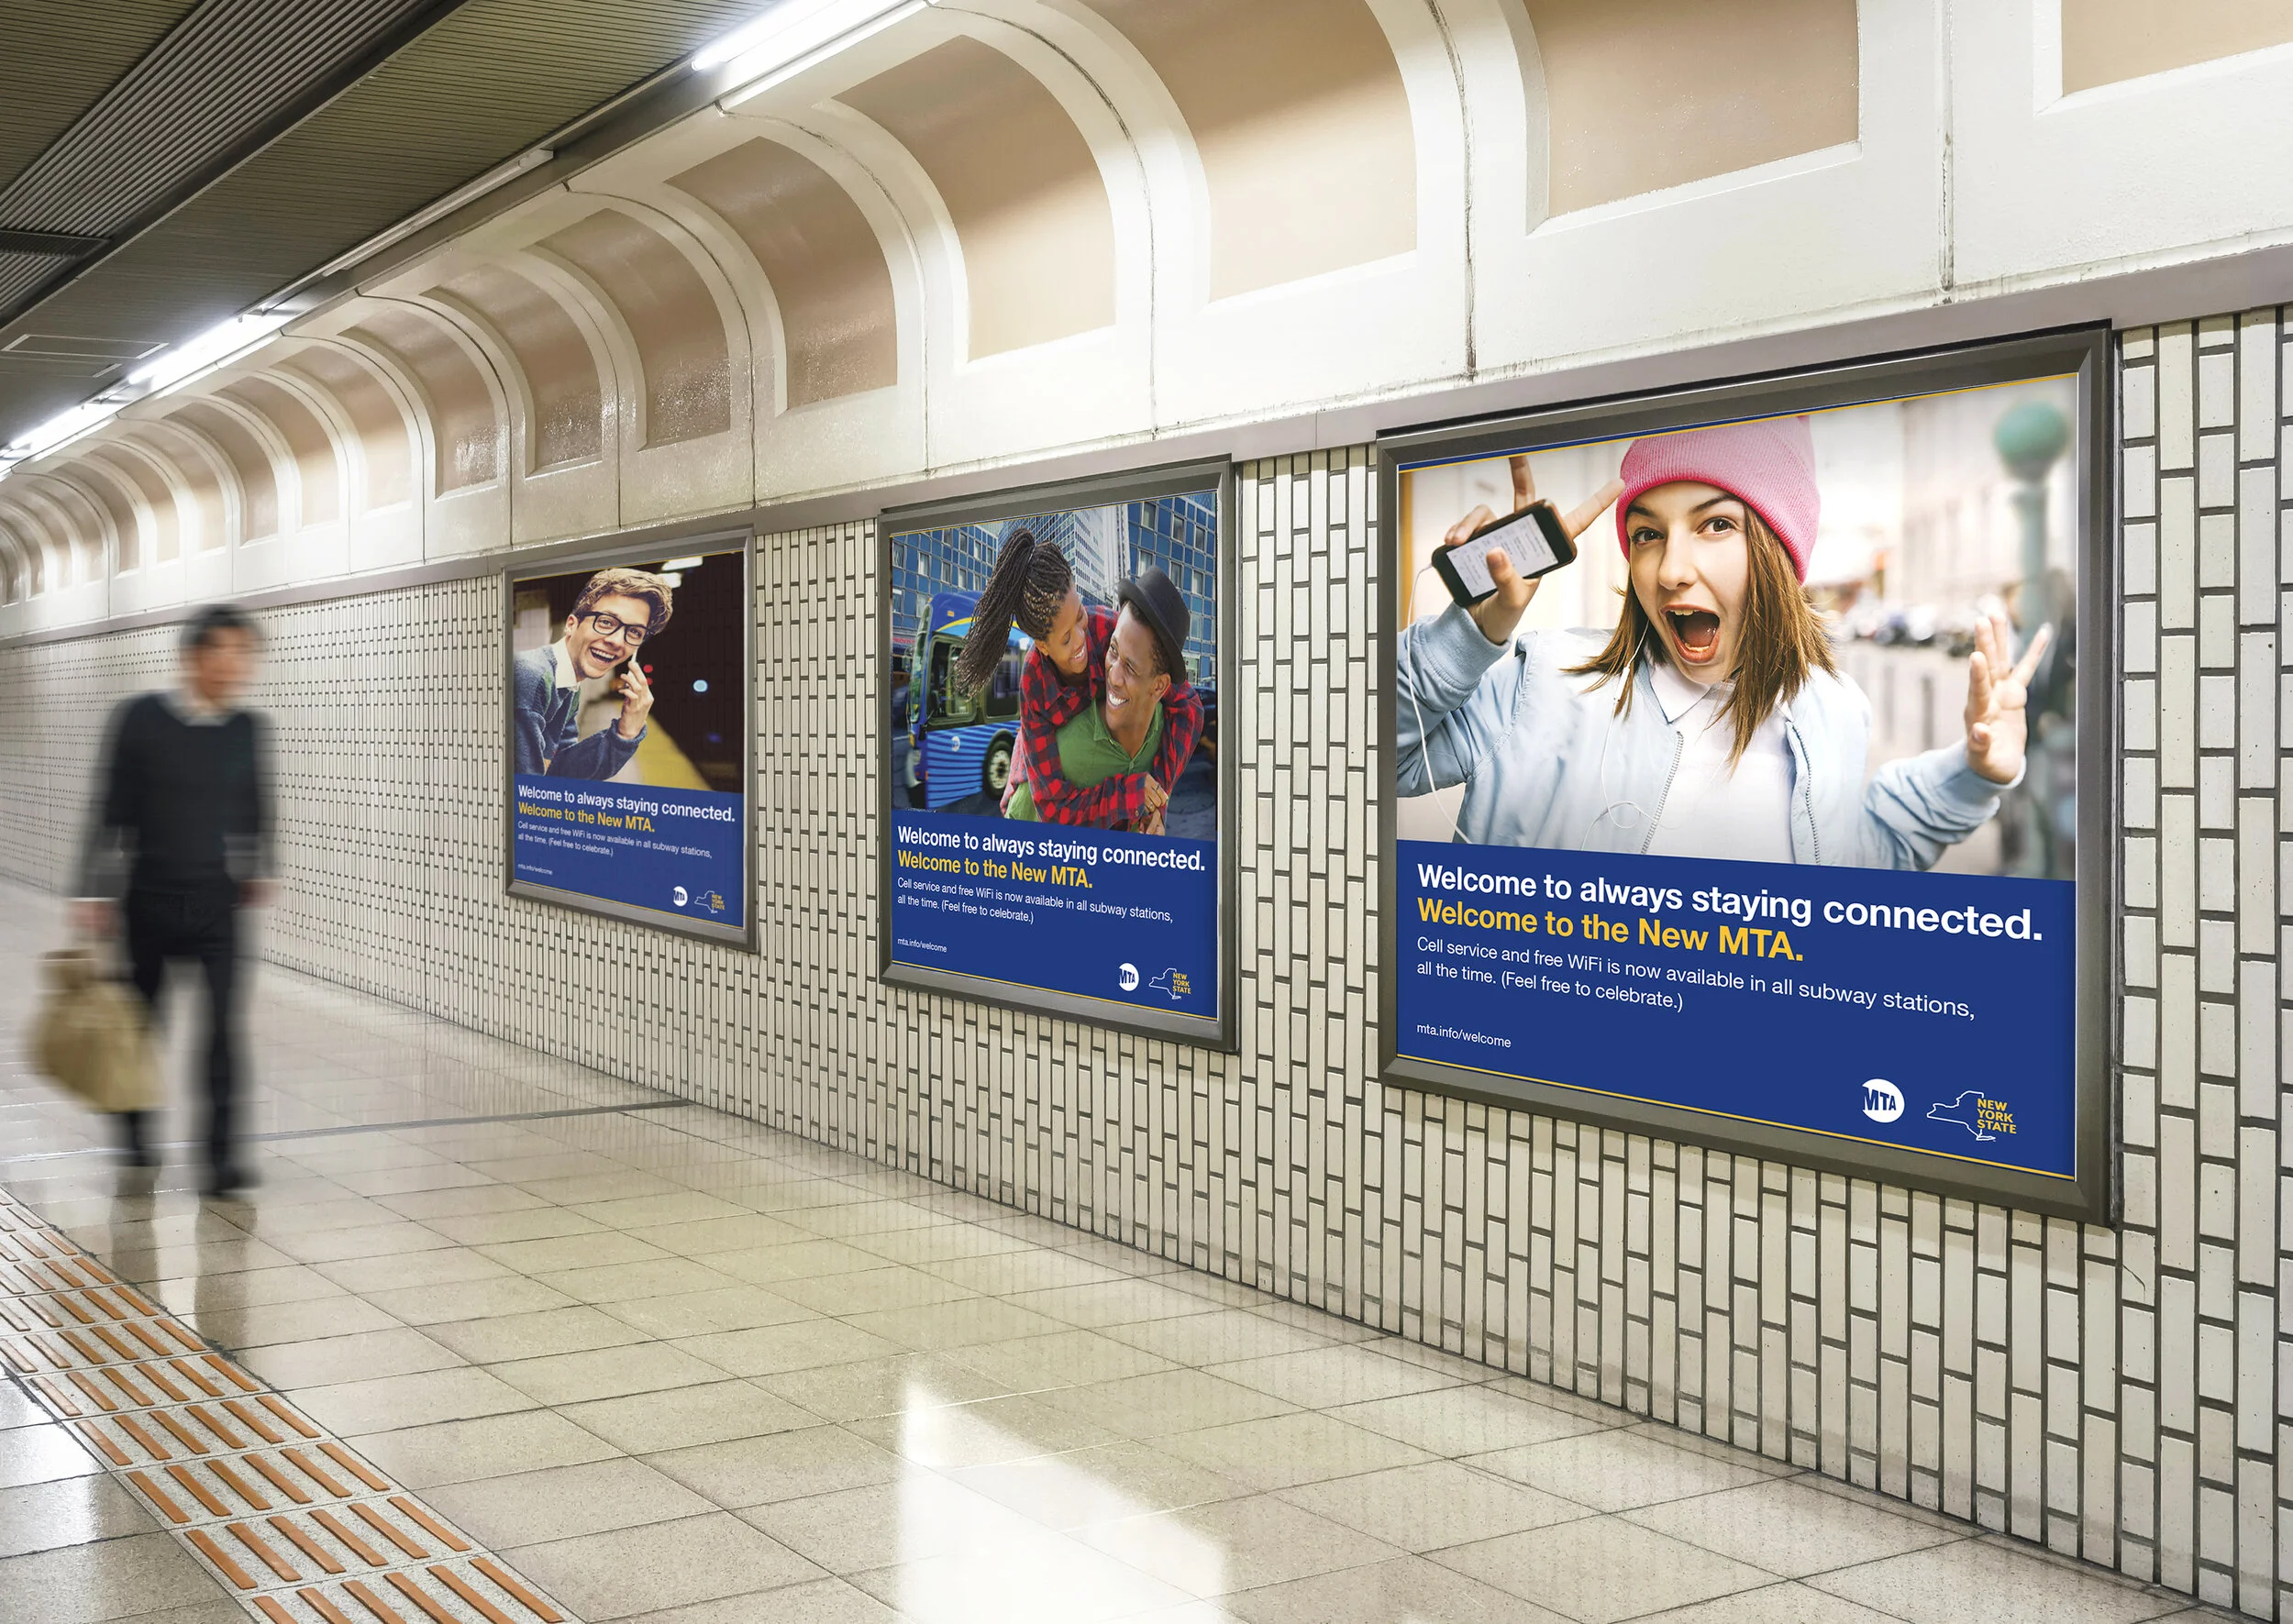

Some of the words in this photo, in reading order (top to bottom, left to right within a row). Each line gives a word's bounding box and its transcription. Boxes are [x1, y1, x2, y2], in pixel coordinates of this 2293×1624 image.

[517, 784, 562, 801] Welcome
[563, 790, 575, 802] to
[576, 791, 615, 810] always
[615, 796, 659, 815] staying
[661, 802, 736, 822] connected.
[517, 801, 563, 819] Welcome
[564, 808, 576, 821] to
[577, 809, 595, 823] the
[597, 811, 623, 827] New
[625, 814, 656, 832] MTA.
[517, 820, 528, 829] Cell
[528, 823, 548, 832] service
[559, 826, 571, 835] free
[571, 829, 586, 837] WiFi
[585, 831, 593, 839] is
[606, 835, 635, 845] available
[636, 838, 642, 846] in
[642, 840, 651, 848] all
[652, 842, 680, 855] subway
[680, 845, 713, 858] stations,
[897, 825, 961, 848] Welcome
[963, 832, 979, 849] to
[981, 833, 1035, 857] always
[1038, 839, 1098, 866] staying
[1102, 847, 1205, 870] connected.
[897, 849, 961, 873] Welcome
[964, 857, 980, 875] to
[982, 858, 1008, 878] the
[1012, 861, 1047, 882] New
[1051, 865, 1093, 888] MTA.
[897, 877, 913, 888] Cell
[913, 880, 941, 891] service
[941, 884, 958, 894] and
[958, 884, 974, 896] free
[975, 887, 994, 899] WiFi
[995, 889, 1003, 900] is
[1004, 892, 1024, 902] now
[1025, 894, 1064, 908] available
[1066, 898, 1075, 909] in
[1076, 900, 1088, 911] all
[1089, 901, 1127, 918] subway
[1129, 906, 1173, 923] stations,
[897, 894, 906, 903] all
[907, 895, 920, 906] the
[920, 897, 940, 909] time.
[941, 899, 960, 911] (Feel
[961, 901, 978, 914] free
[979, 904, 988, 915] to
[989, 907, 1034, 924] celebrate.)
[1417, 863, 1537, 897] Welcome
[1543, 874, 1572, 900] to
[1579, 877, 1683, 913] always
[1691, 886, 1811, 927] staying
[1823, 900, 2043, 941] connected.
[1417, 897, 1538, 934] Welcome
[1544, 911, 1574, 937] to
[1580, 913, 1629, 944] the
[1639, 918, 1709, 951] New
[1719, 925, 1803, 962] MTA.
[898, 939, 947, 952] mta.info/welcome
[1172, 972, 1188, 980] NEW
[1172, 986, 1191, 994] STATE
[1416, 961, 1432, 976] all
[1435, 963, 1458, 978] the
[1461, 966, 1497, 984] time.
[1501, 970, 1536, 989] (Feel
[1540, 975, 1571, 994] free
[1575, 980, 1590, 997] to
[1595, 985, 1683, 1013] celebrate.)
[1417, 936, 1443, 954] Cell
[1446, 943, 1498, 959] service
[1501, 949, 1530, 964] and
[1534, 949, 1564, 967] free
[1567, 954, 1602, 973] WiFi
[1607, 958, 1621, 975] is
[1625, 964, 1661, 979] now
[1666, 968, 1745, 989] available
[1750, 974, 1766, 992] in
[1771, 978, 1792, 996] all
[1799, 983, 1878, 1010] subway
[1883, 991, 1975, 1022] stations,
[1417, 1024, 1511, 1047] mta.info/welcome
[1862, 1087, 1897, 1111] MTA
[1977, 1099, 2008, 1111] NEW
[1977, 1109, 2013, 1123] YORK
[1977, 1120, 2017, 1134] STATE
